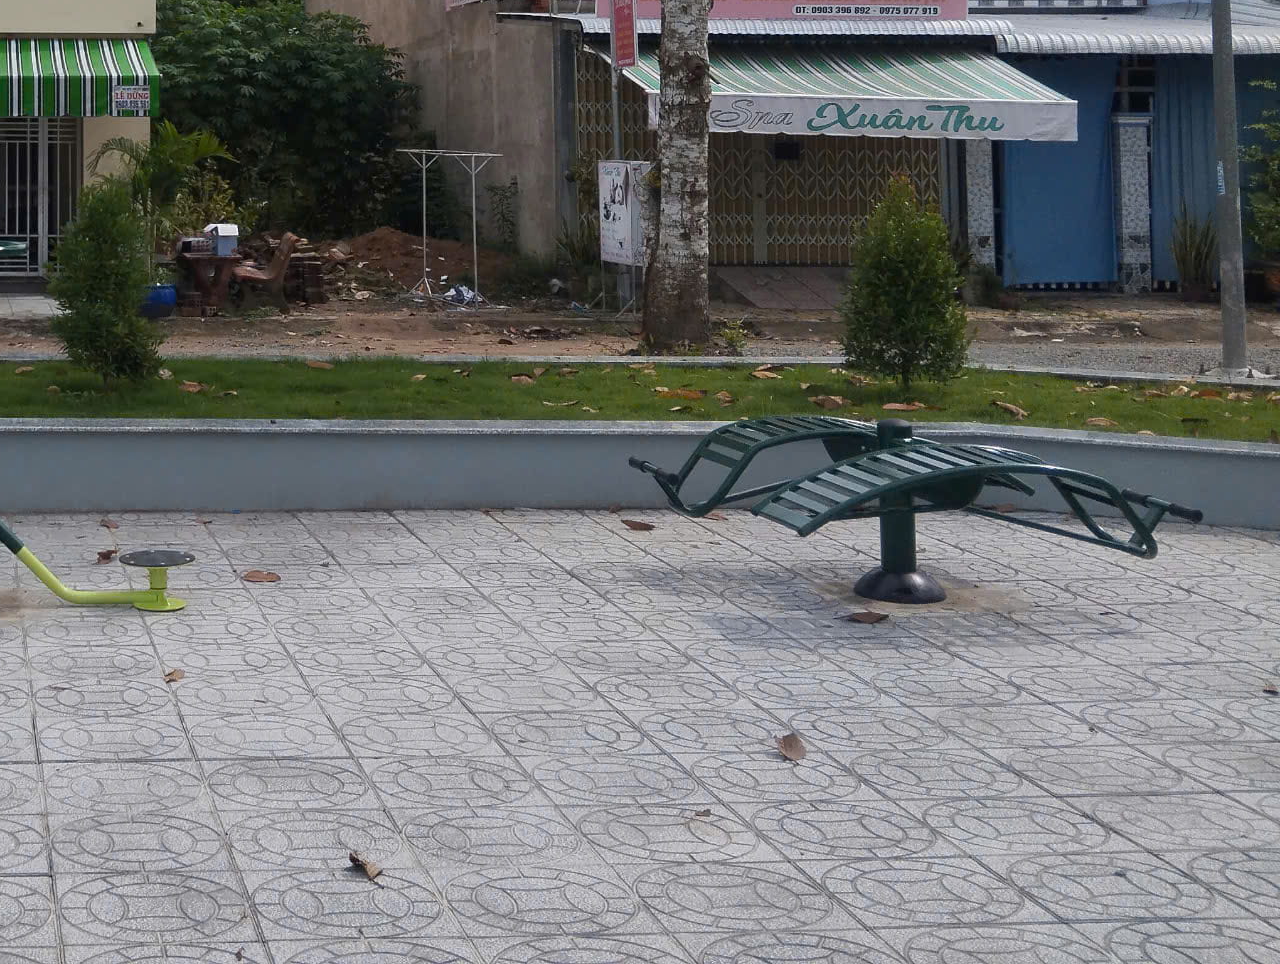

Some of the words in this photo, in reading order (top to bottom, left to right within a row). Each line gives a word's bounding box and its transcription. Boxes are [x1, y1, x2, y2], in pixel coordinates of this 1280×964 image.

[811, 6, 833, 14] 0903
[835, 6, 852, 14] 396
[879, 7, 901, 15] 0975
[903, 7, 920, 15] 077
[921, 7, 938, 15] 919
[710, 99, 794, 129] Spa
[807, 102, 933, 132] Xuân
[926, 105, 1004, 132] Thu
